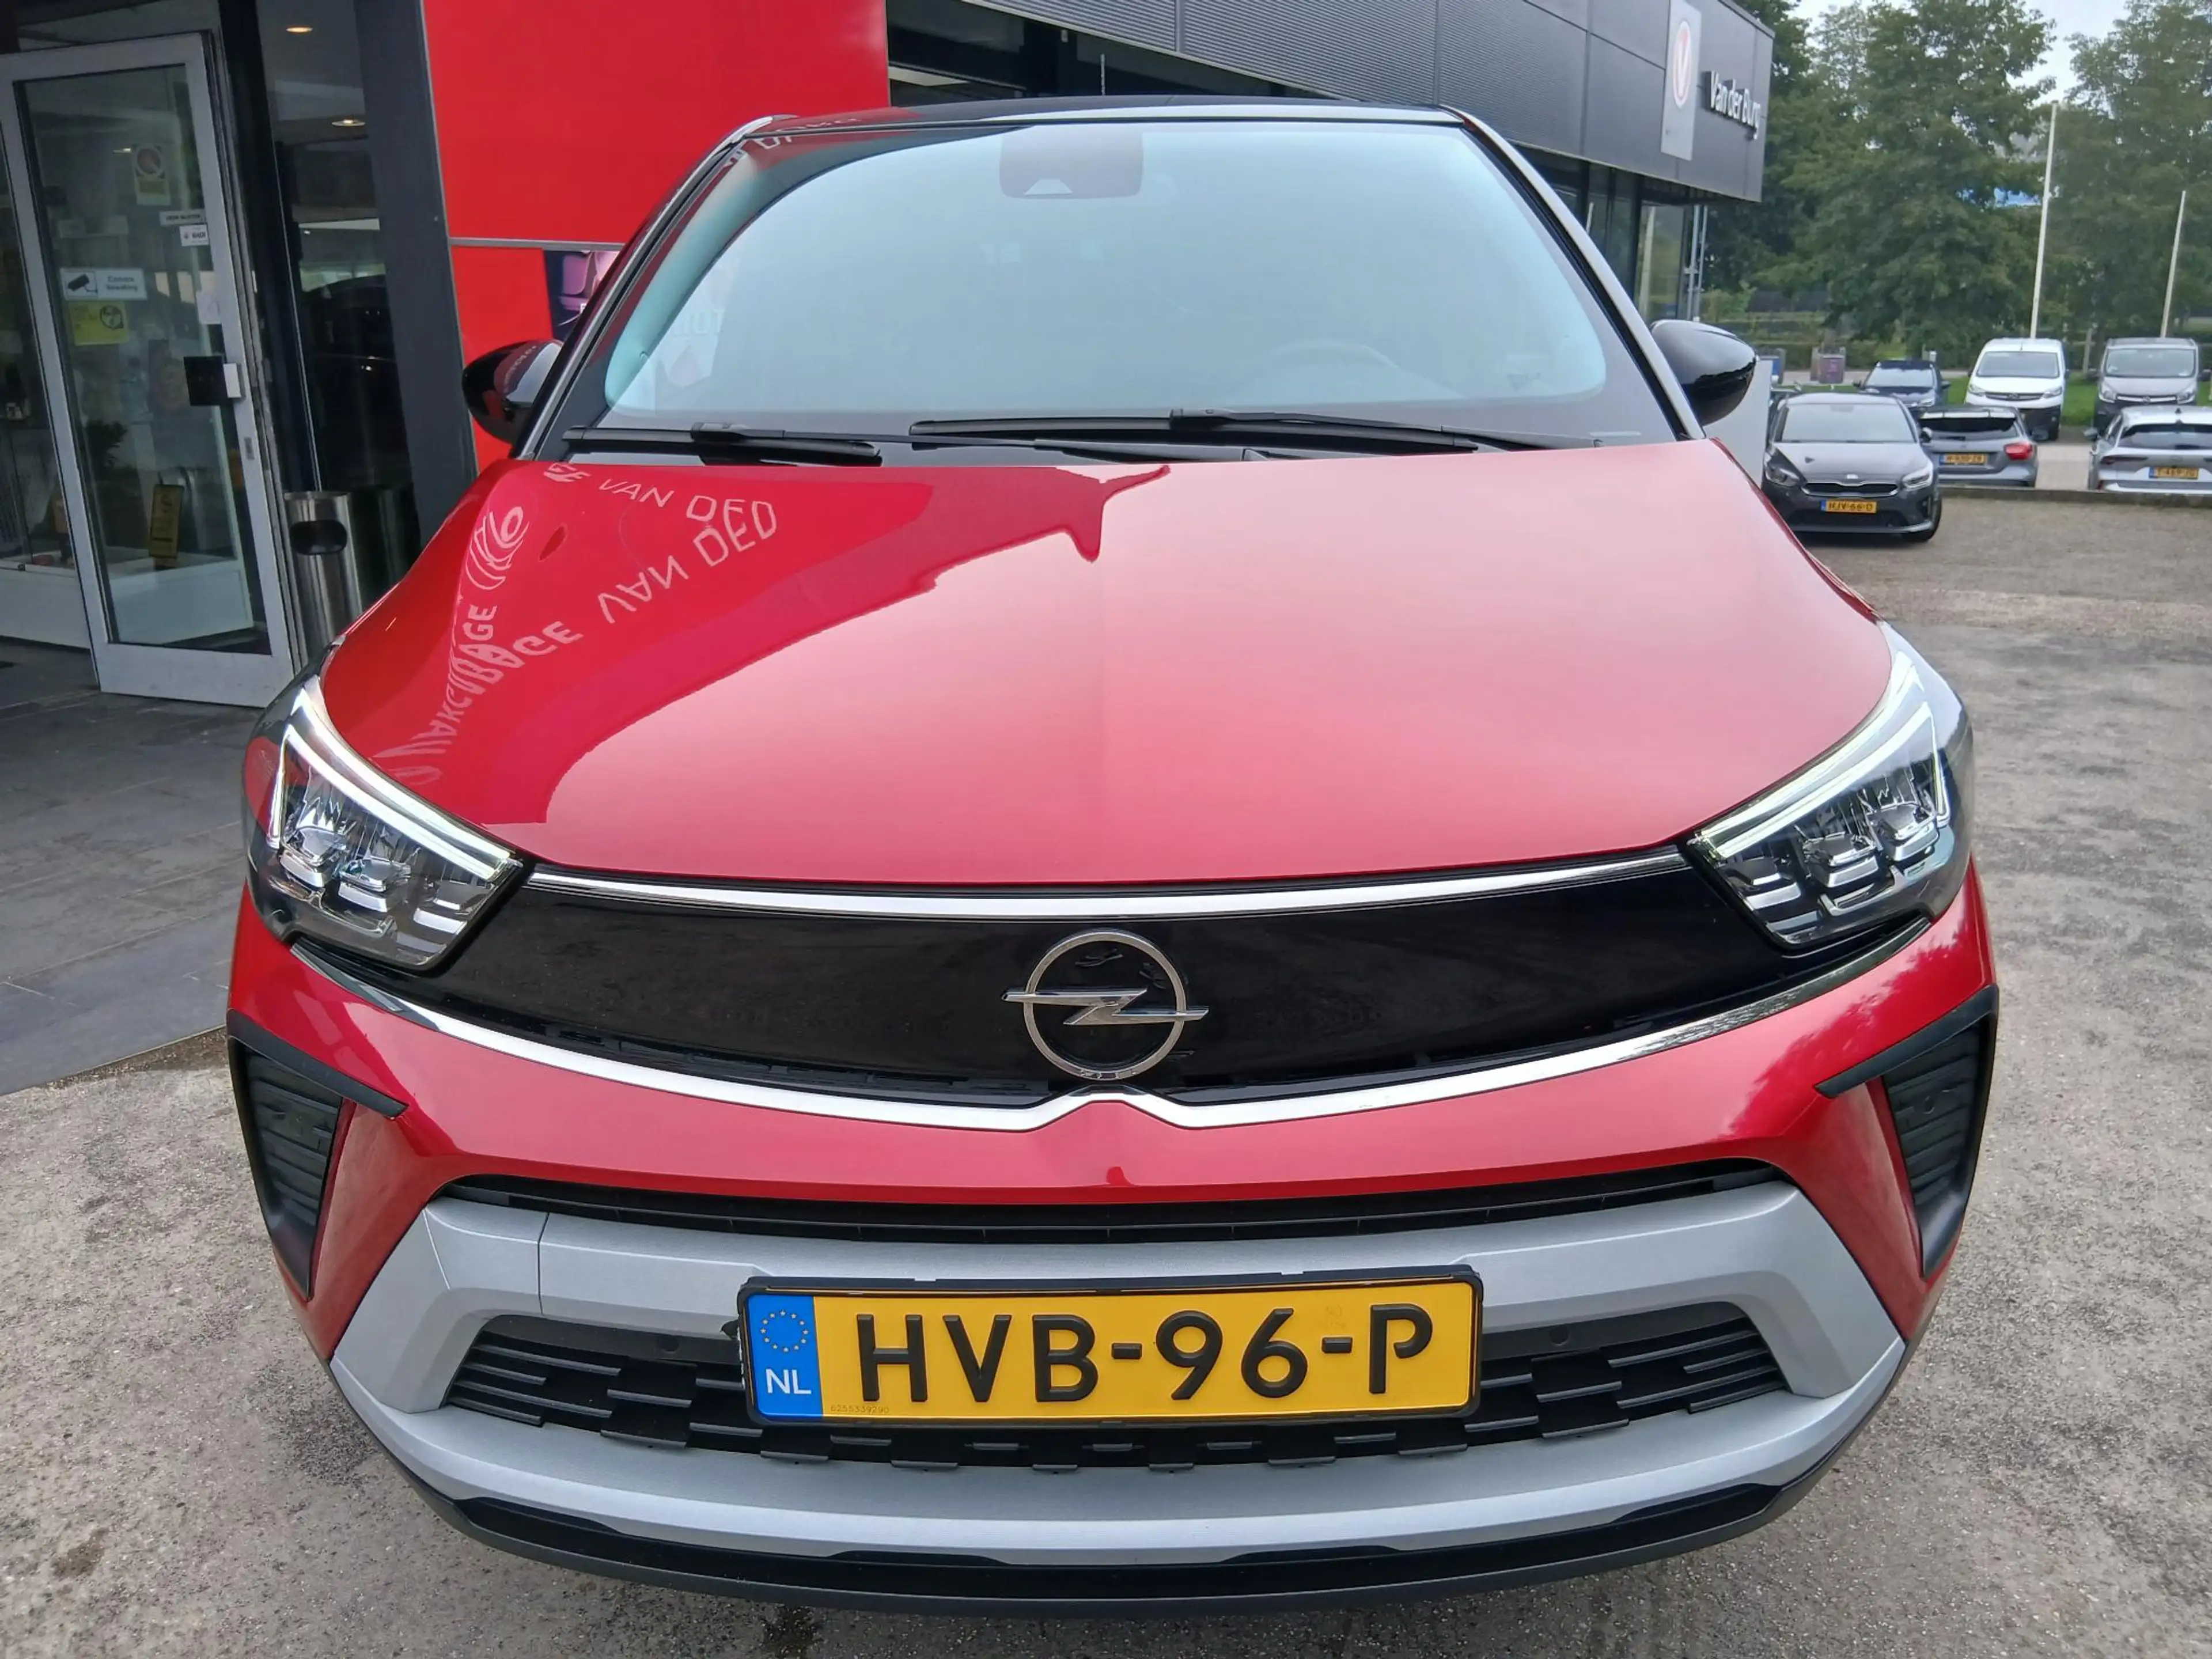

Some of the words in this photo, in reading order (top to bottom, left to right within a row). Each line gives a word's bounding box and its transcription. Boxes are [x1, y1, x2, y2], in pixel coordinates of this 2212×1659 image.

[1711, 70, 1728, 114] Van
[856, 1303, 1433, 1403] HVB-96-P
[766, 1369, 812, 1395] NL
